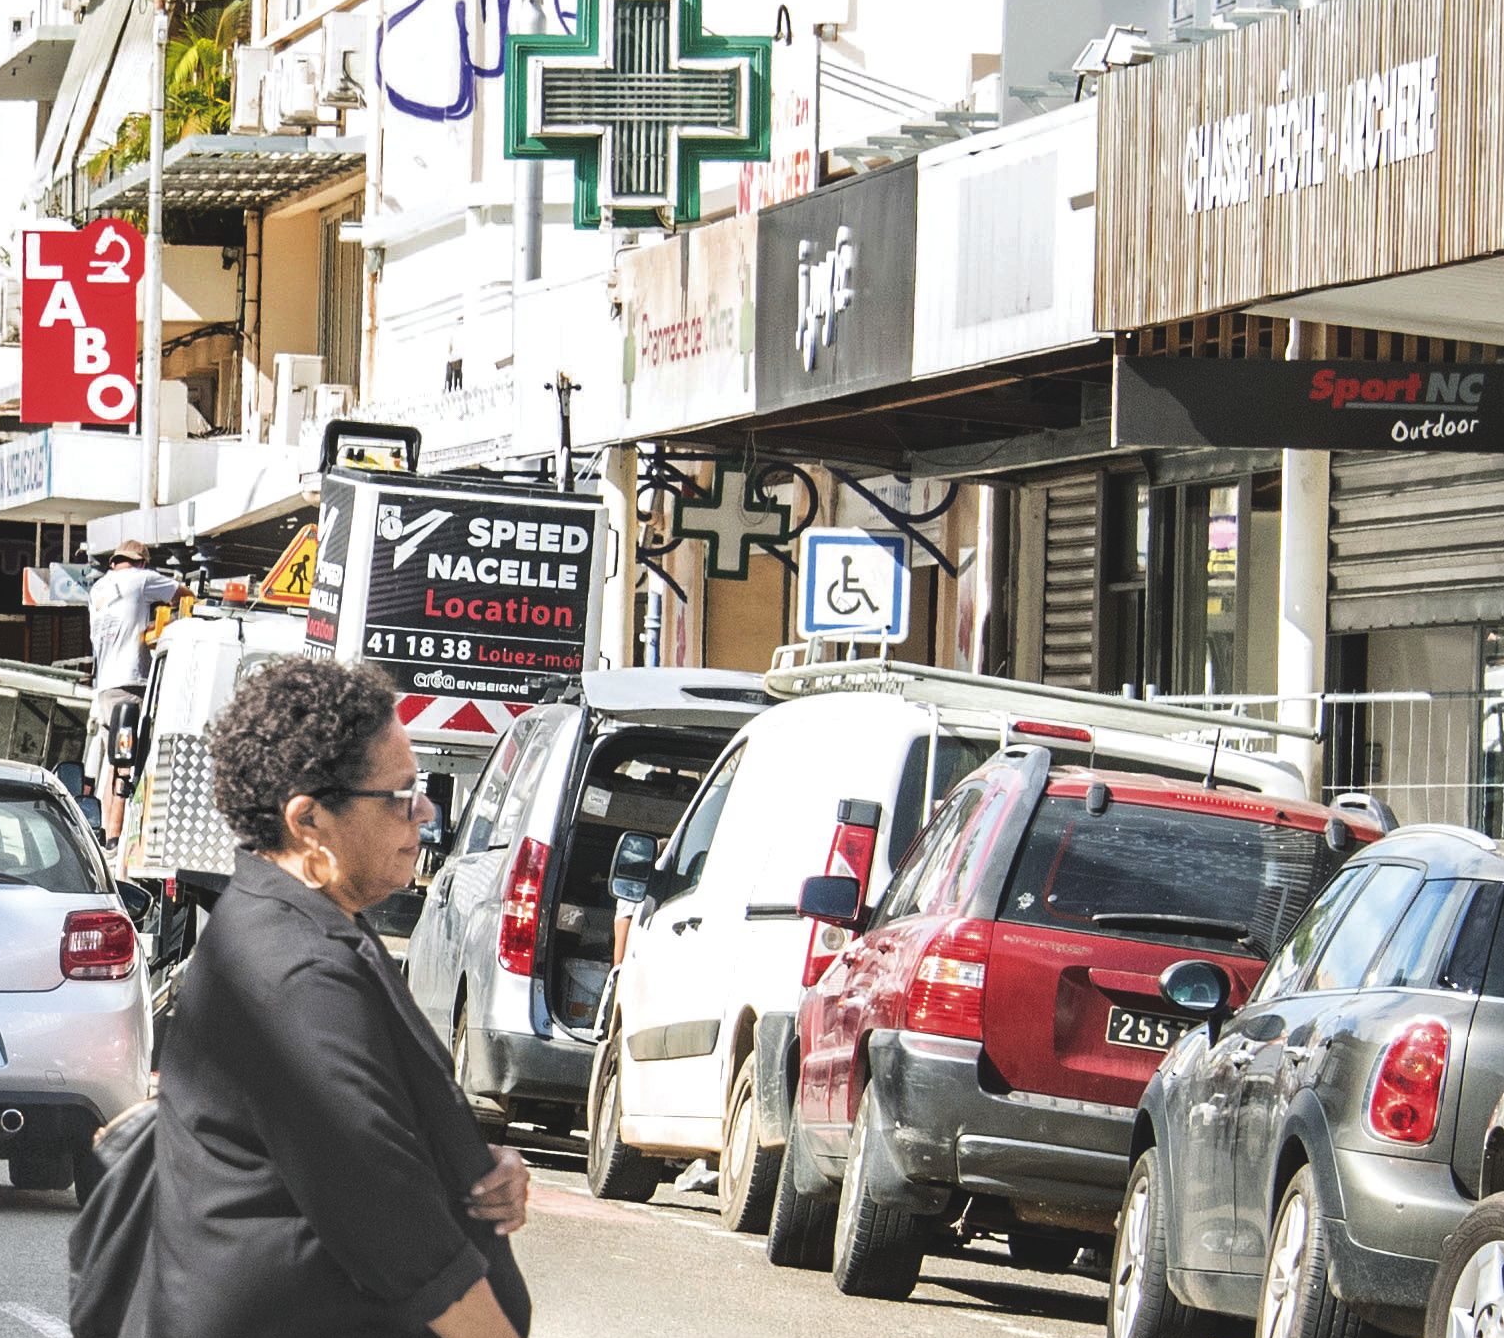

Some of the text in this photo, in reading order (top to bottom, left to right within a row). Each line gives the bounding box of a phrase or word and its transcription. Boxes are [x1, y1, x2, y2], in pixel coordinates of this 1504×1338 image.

[1184, 54, 1438, 216] CHASSE PÊCHE ARCHERIE
[26, 233, 136, 420] LABO
[1309, 369, 1422, 408] Sport
[1392, 413, 1479, 442] Outdoor
[467, 518, 589, 555] SPEED
[427, 553, 579, 591] NACELLE
[424, 589, 573, 627] Location
[367, 632, 581, 670] 41 18 38 Louez-moi
